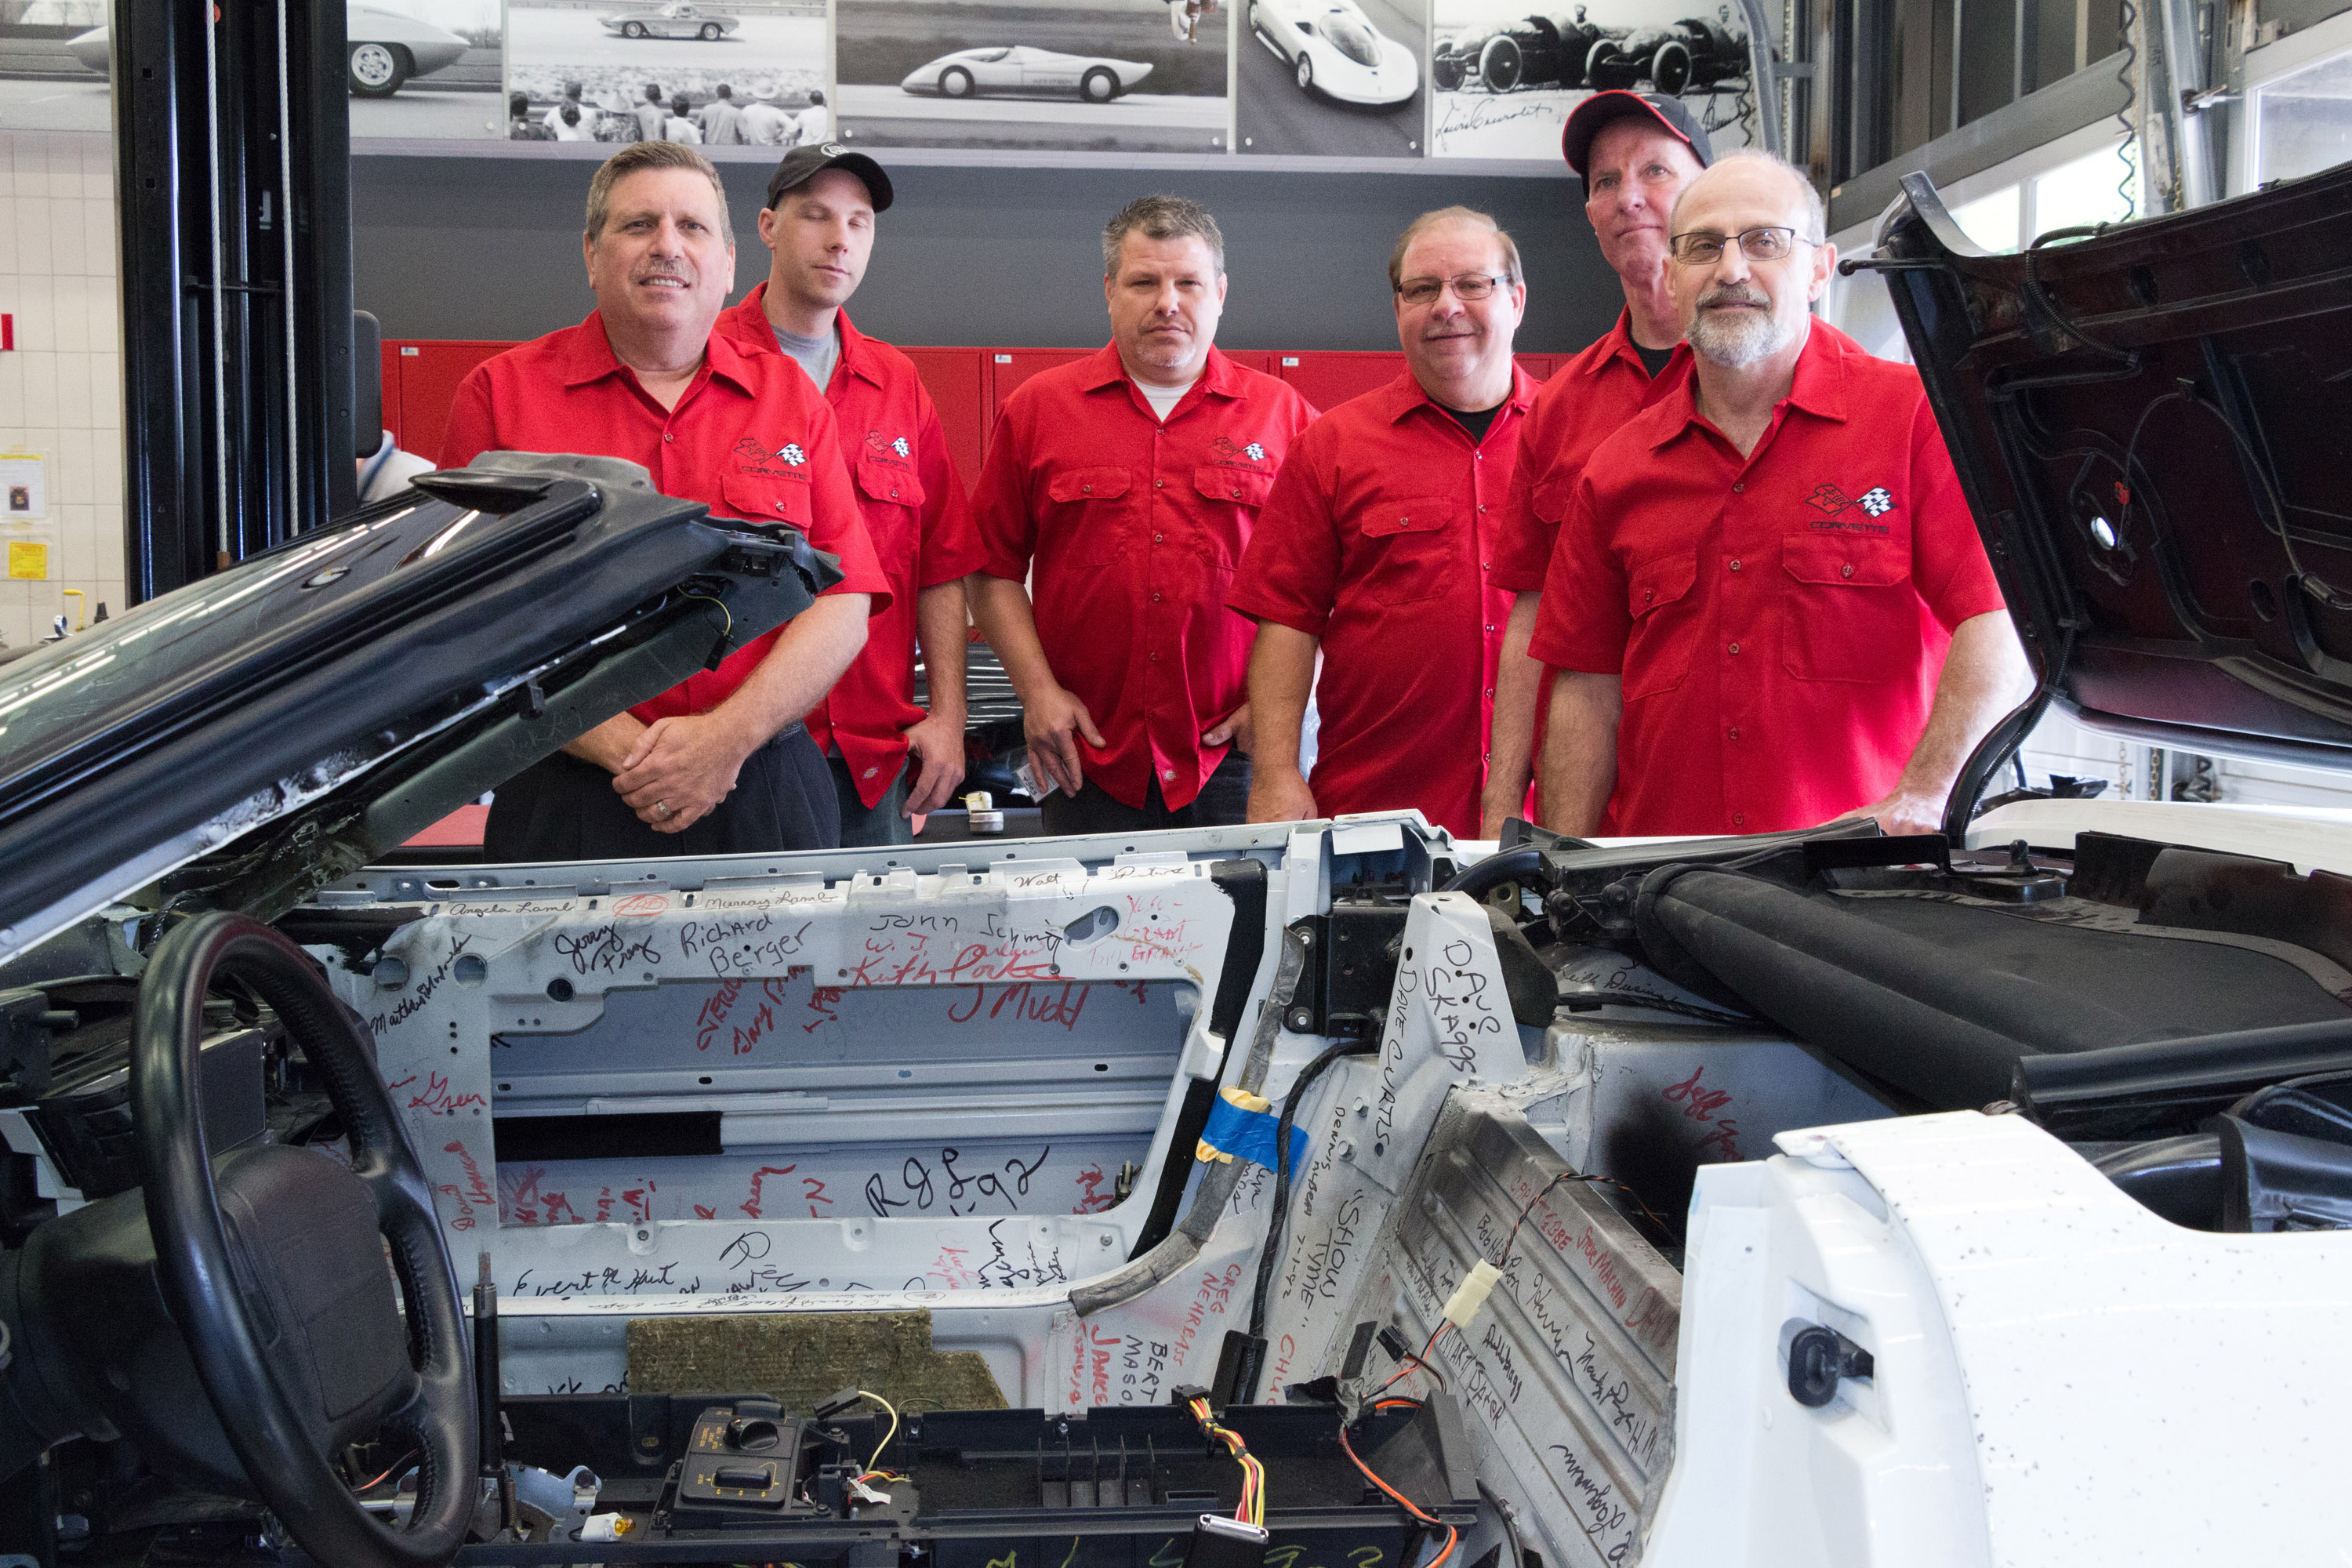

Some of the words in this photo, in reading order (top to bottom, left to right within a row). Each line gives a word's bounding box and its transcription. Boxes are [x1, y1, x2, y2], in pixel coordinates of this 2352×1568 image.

[869, 456, 910, 470] CORVETTE
[1213, 459, 1264, 470] CORVETTE
[742, 466, 808, 480] CORVETTE
[1809, 521, 1889, 533] CORVETTE
[706, 898, 770, 909] Murray
[775, 891, 838, 903] Lamb
[449, 903, 510, 917] Angela
[515, 902, 575, 913] Lamb
[1209, 1262, 1242, 1315] GREG
[1118, 1334, 1144, 1406] MASO
[1140, 1340, 1168, 1403] BERT
